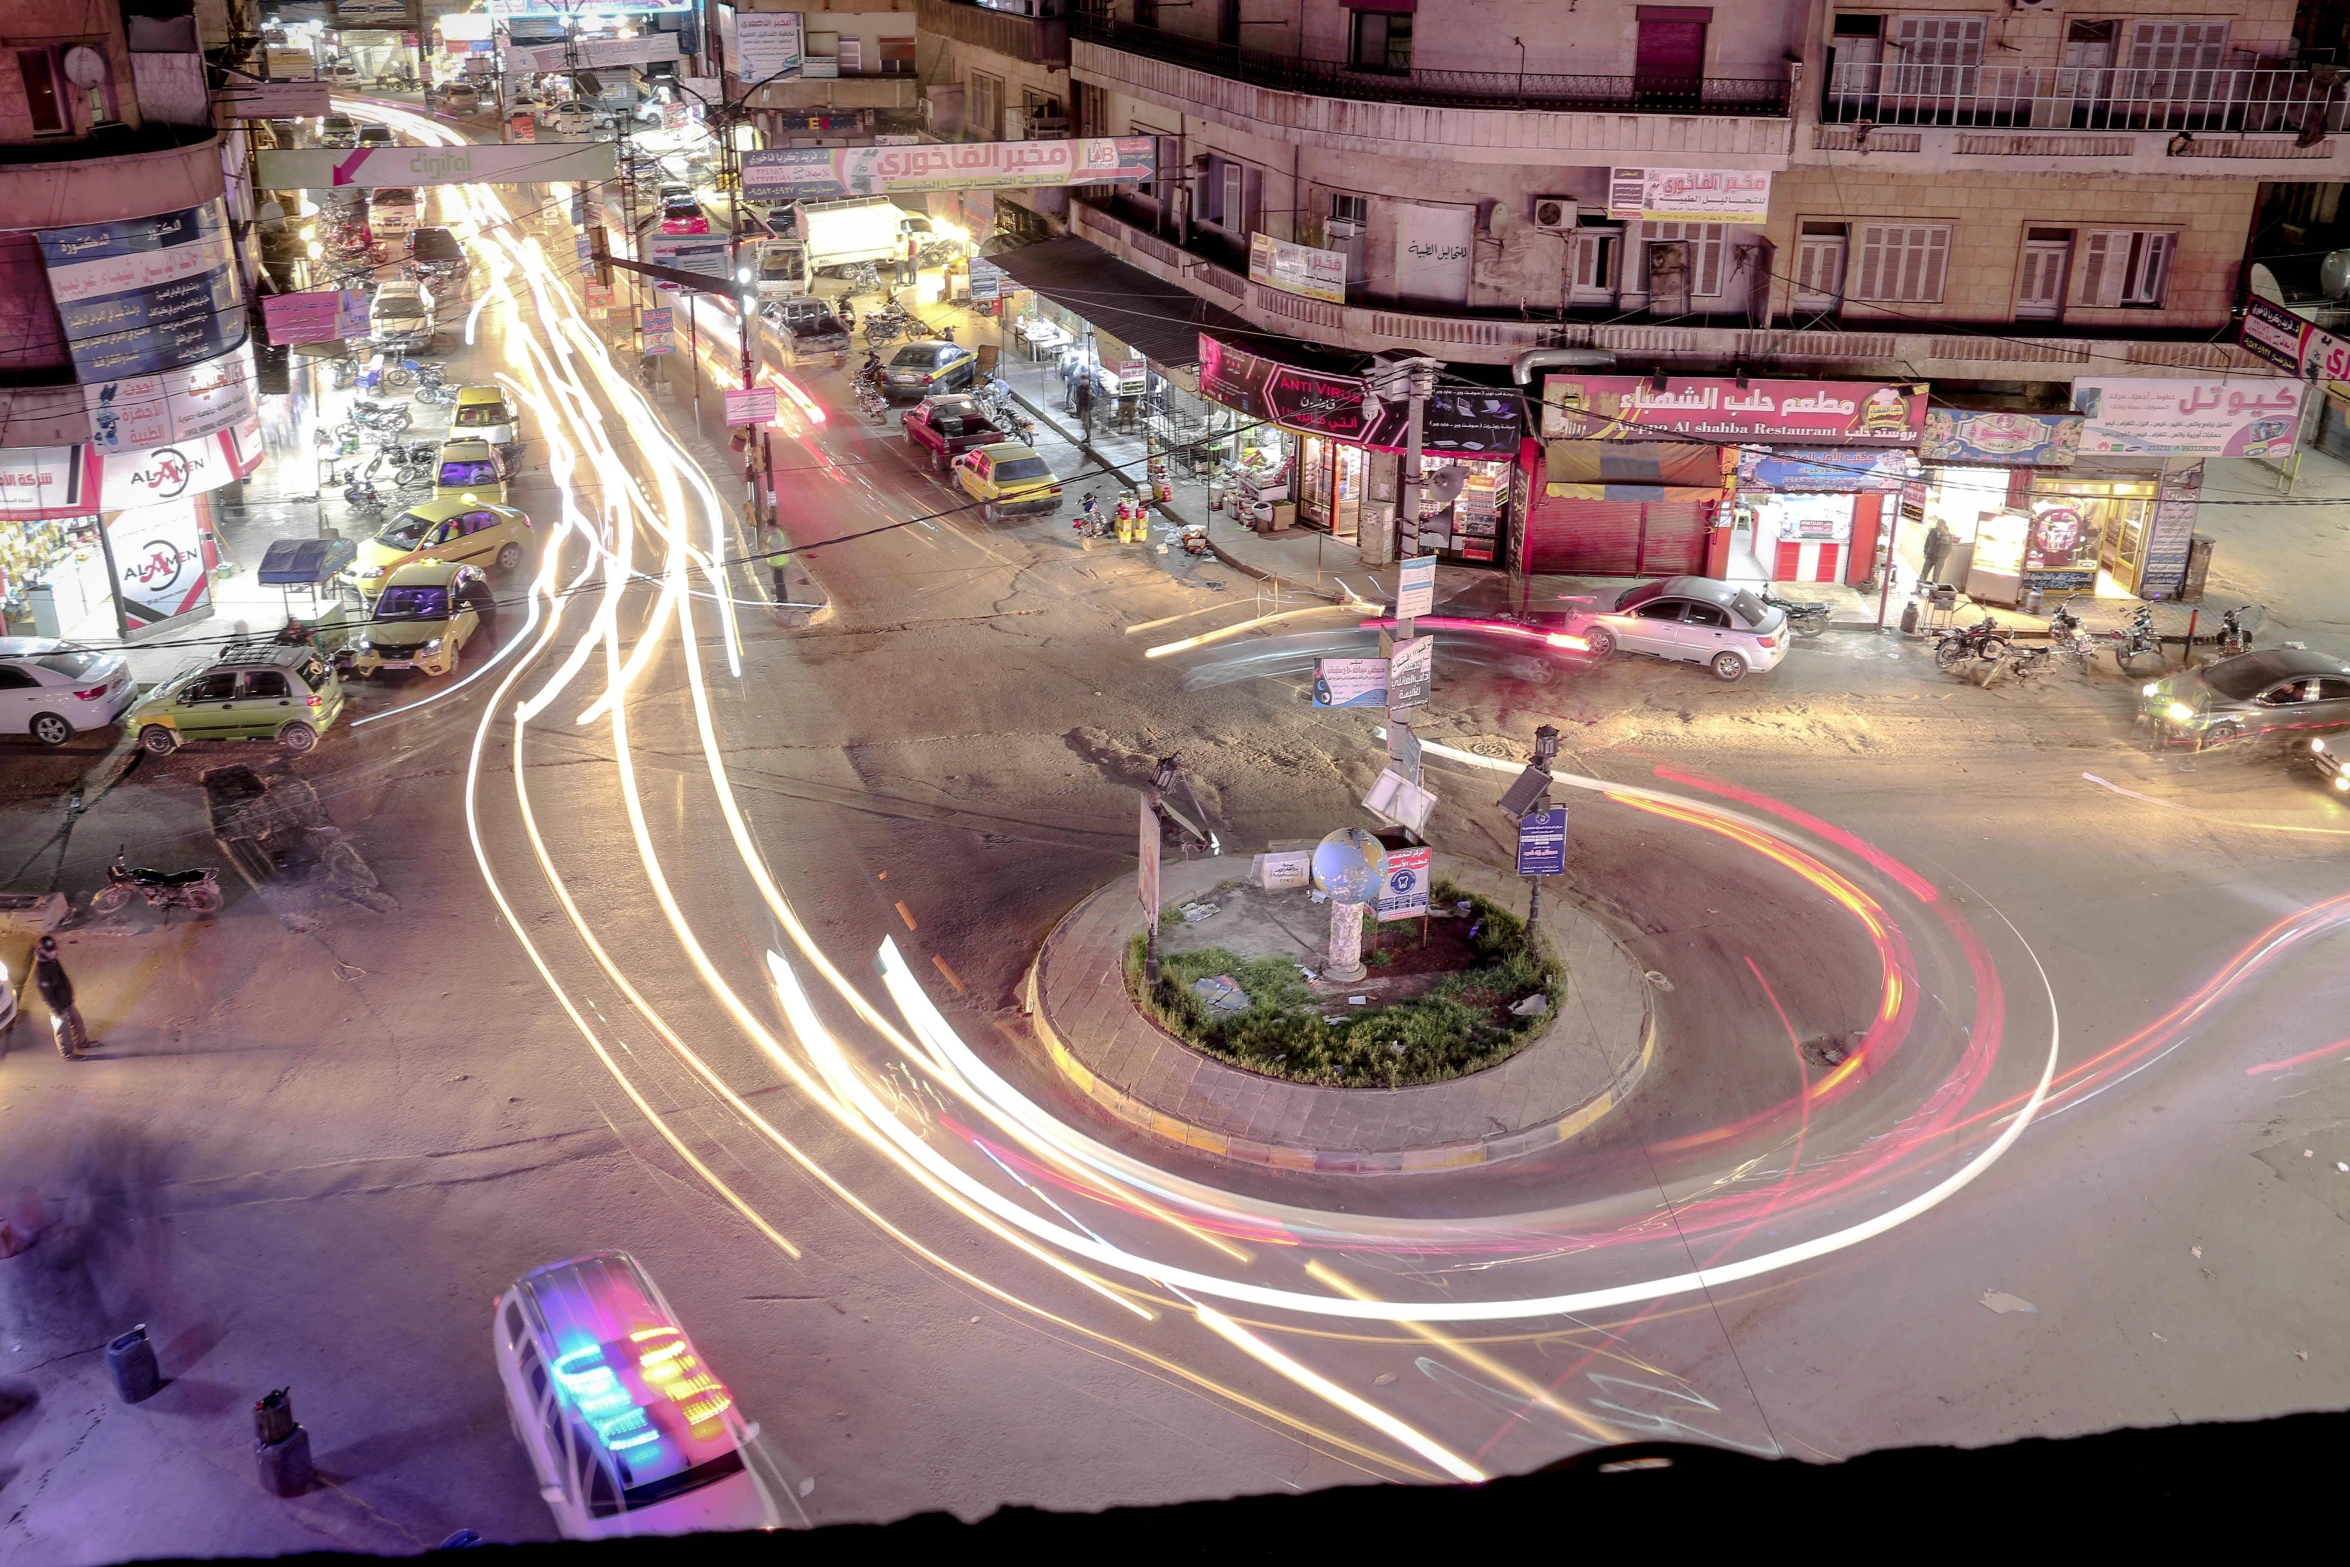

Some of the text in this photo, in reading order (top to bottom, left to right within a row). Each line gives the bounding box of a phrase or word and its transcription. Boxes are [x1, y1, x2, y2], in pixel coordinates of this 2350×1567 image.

[410, 150, 472, 179] digital
[877, 143, 1067, 181] مخبر الفاخوري
[1723, 174, 1767, 194] مخبر
[1620, 385, 1855, 417] مطعم حلب الشهباء
[1613, 421, 1838, 437] Aleppo Al shahba Restaurant
[1873, 427, 1918, 441] بروستد
[18, 472, 53, 488] شركة
